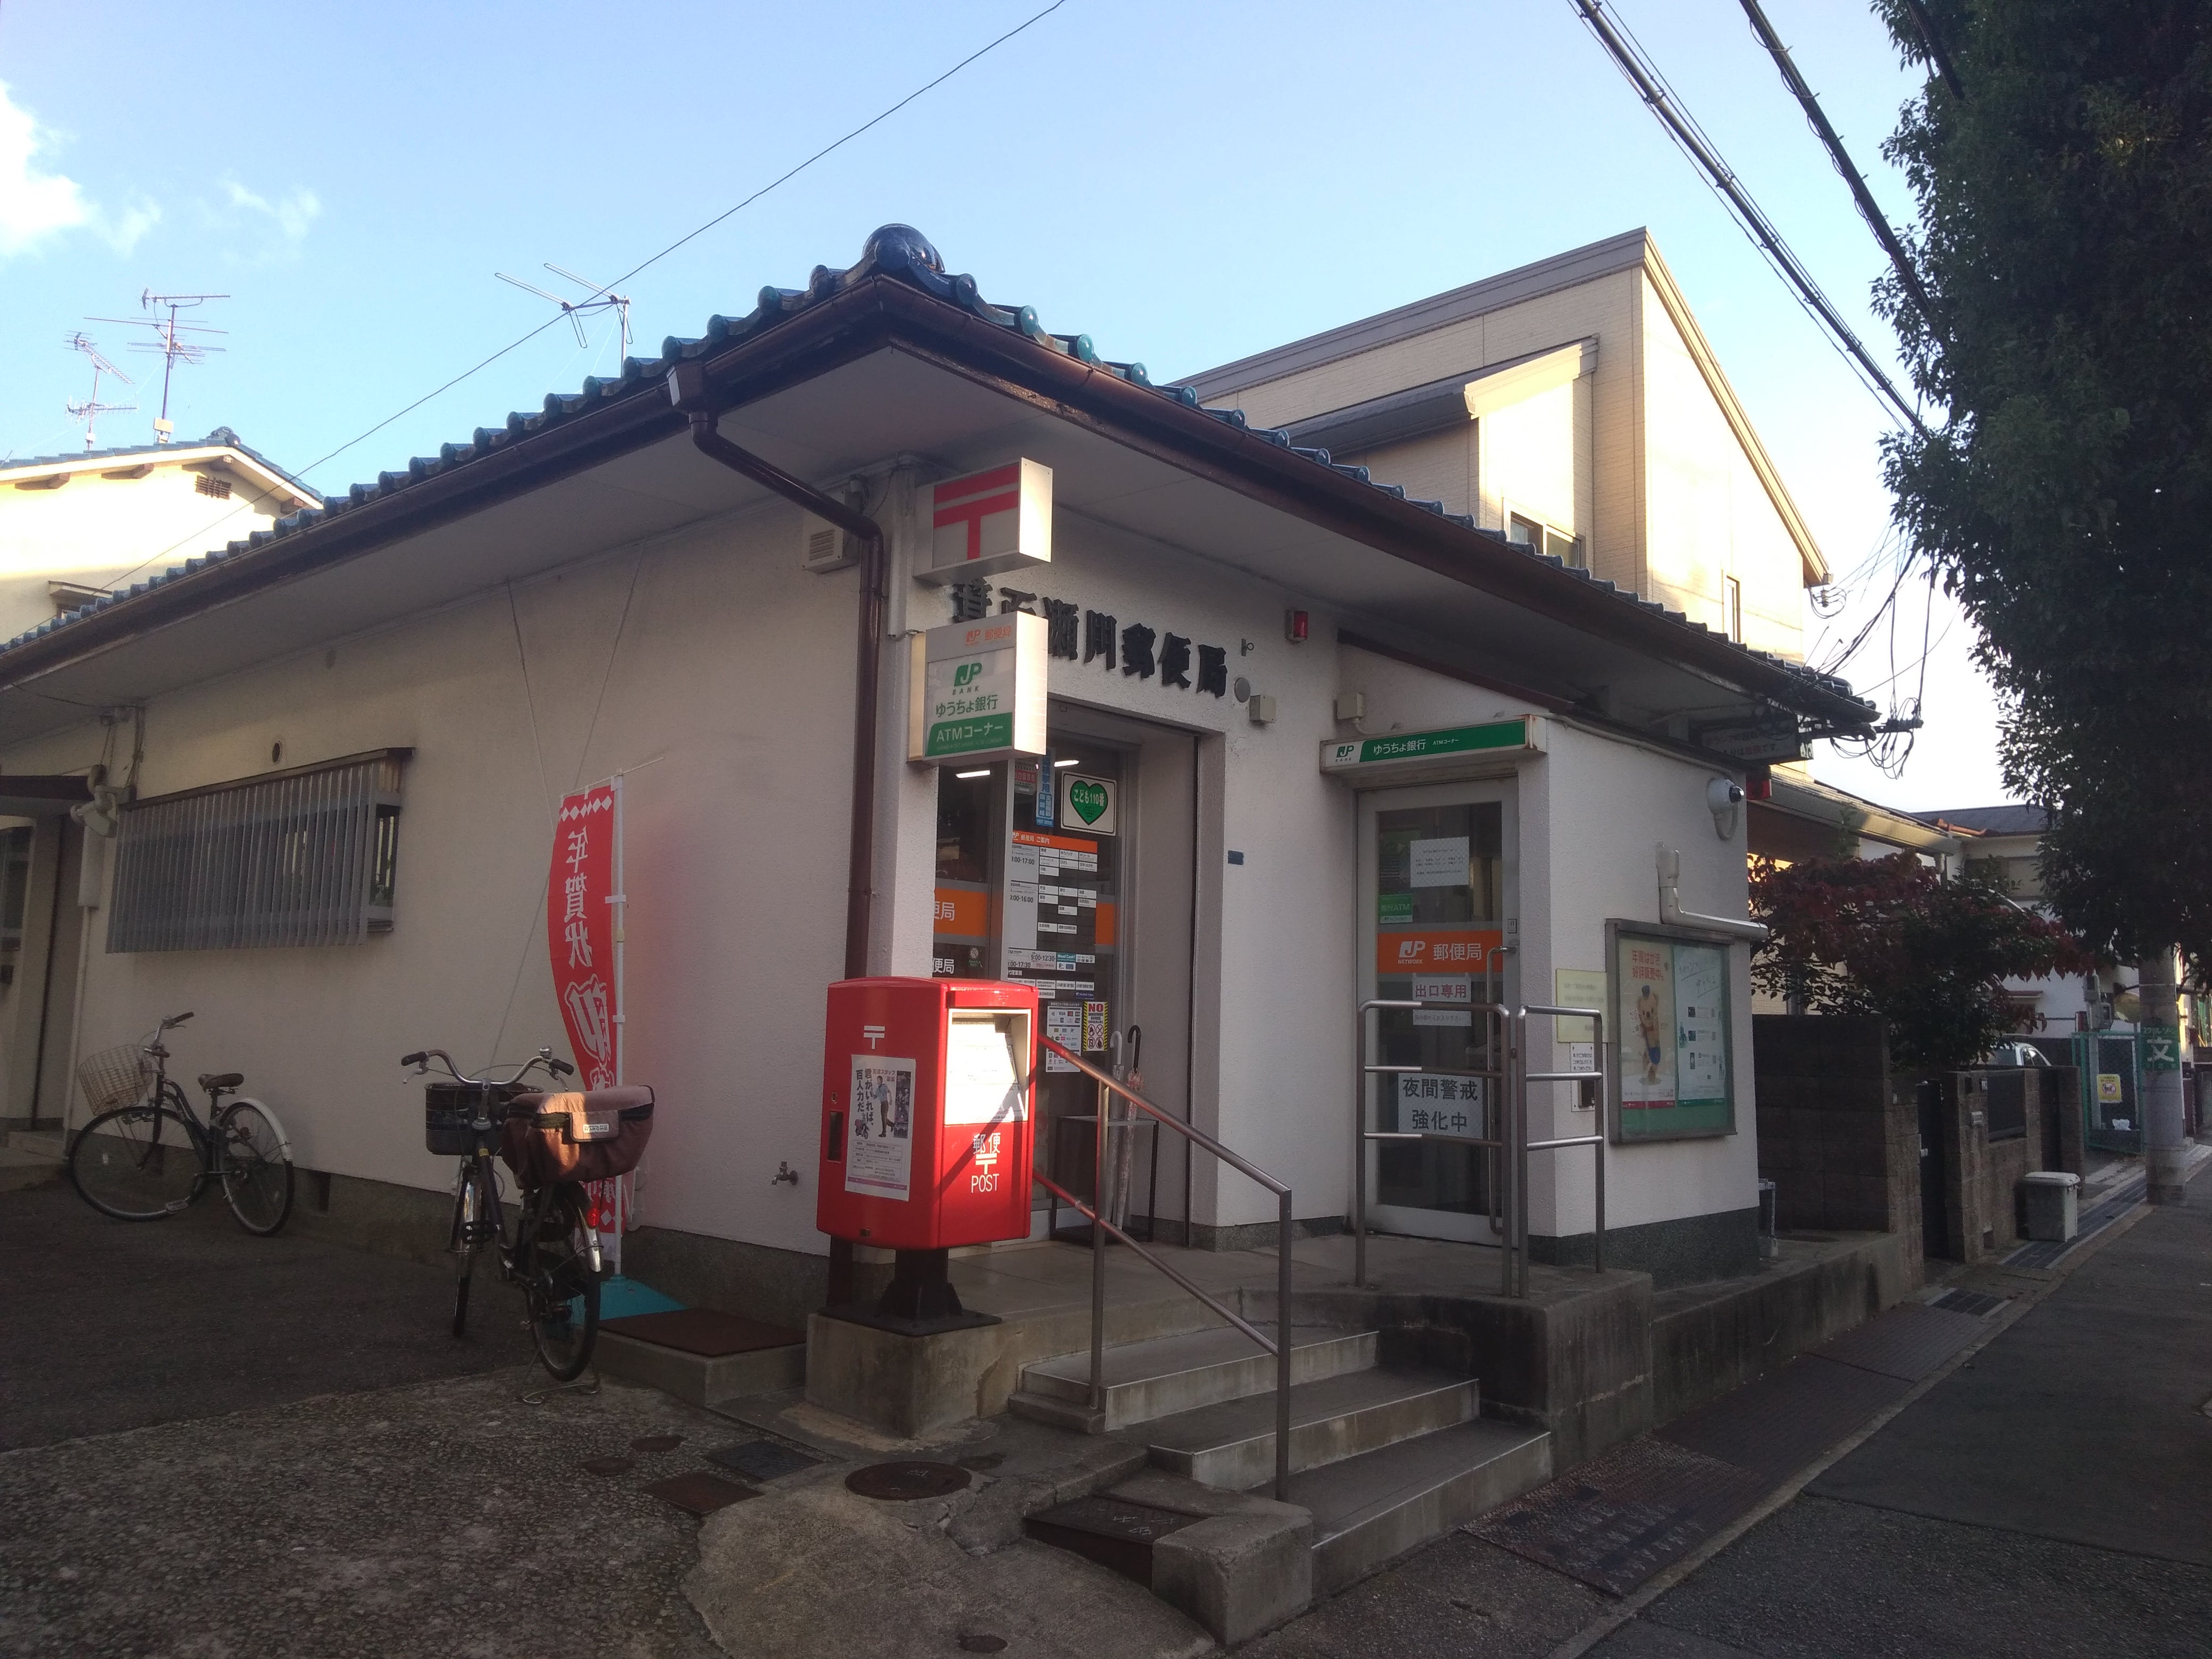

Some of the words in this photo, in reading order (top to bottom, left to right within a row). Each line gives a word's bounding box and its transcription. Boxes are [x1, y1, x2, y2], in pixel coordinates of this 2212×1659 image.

[985, 626, 1011, 641] 郵便局
[954, 663, 982, 687] JP
[952, 686, 979, 695] BANK
[936, 694, 998, 718] ゆうちょ銀行
[936, 722, 1003, 742] ATMコーナー
[1336, 745, 1354, 758] JP
[1373, 739, 1426, 756] ゆうちょ銀行
[1074, 789, 1105, 807] こども110番
[1399, 941, 1426, 958] JP
[1433, 942, 1482, 961] 郵便局
[1632, 950, 1660, 966] 年賀はがき
[1415, 984, 1467, 998] 出口専用
[1088, 1003, 1104, 1012] NO
[856, 1069, 865, 1112] 百人力だ
[865, 1068, 875, 1126] 君がいれば、
[1403, 1077, 1478, 1101] 夜間警戒
[1412, 1109, 1467, 1133] 強化中
[973, 1132, 1001, 1154] 郵便
[971, 1173, 1000, 1193] POST
